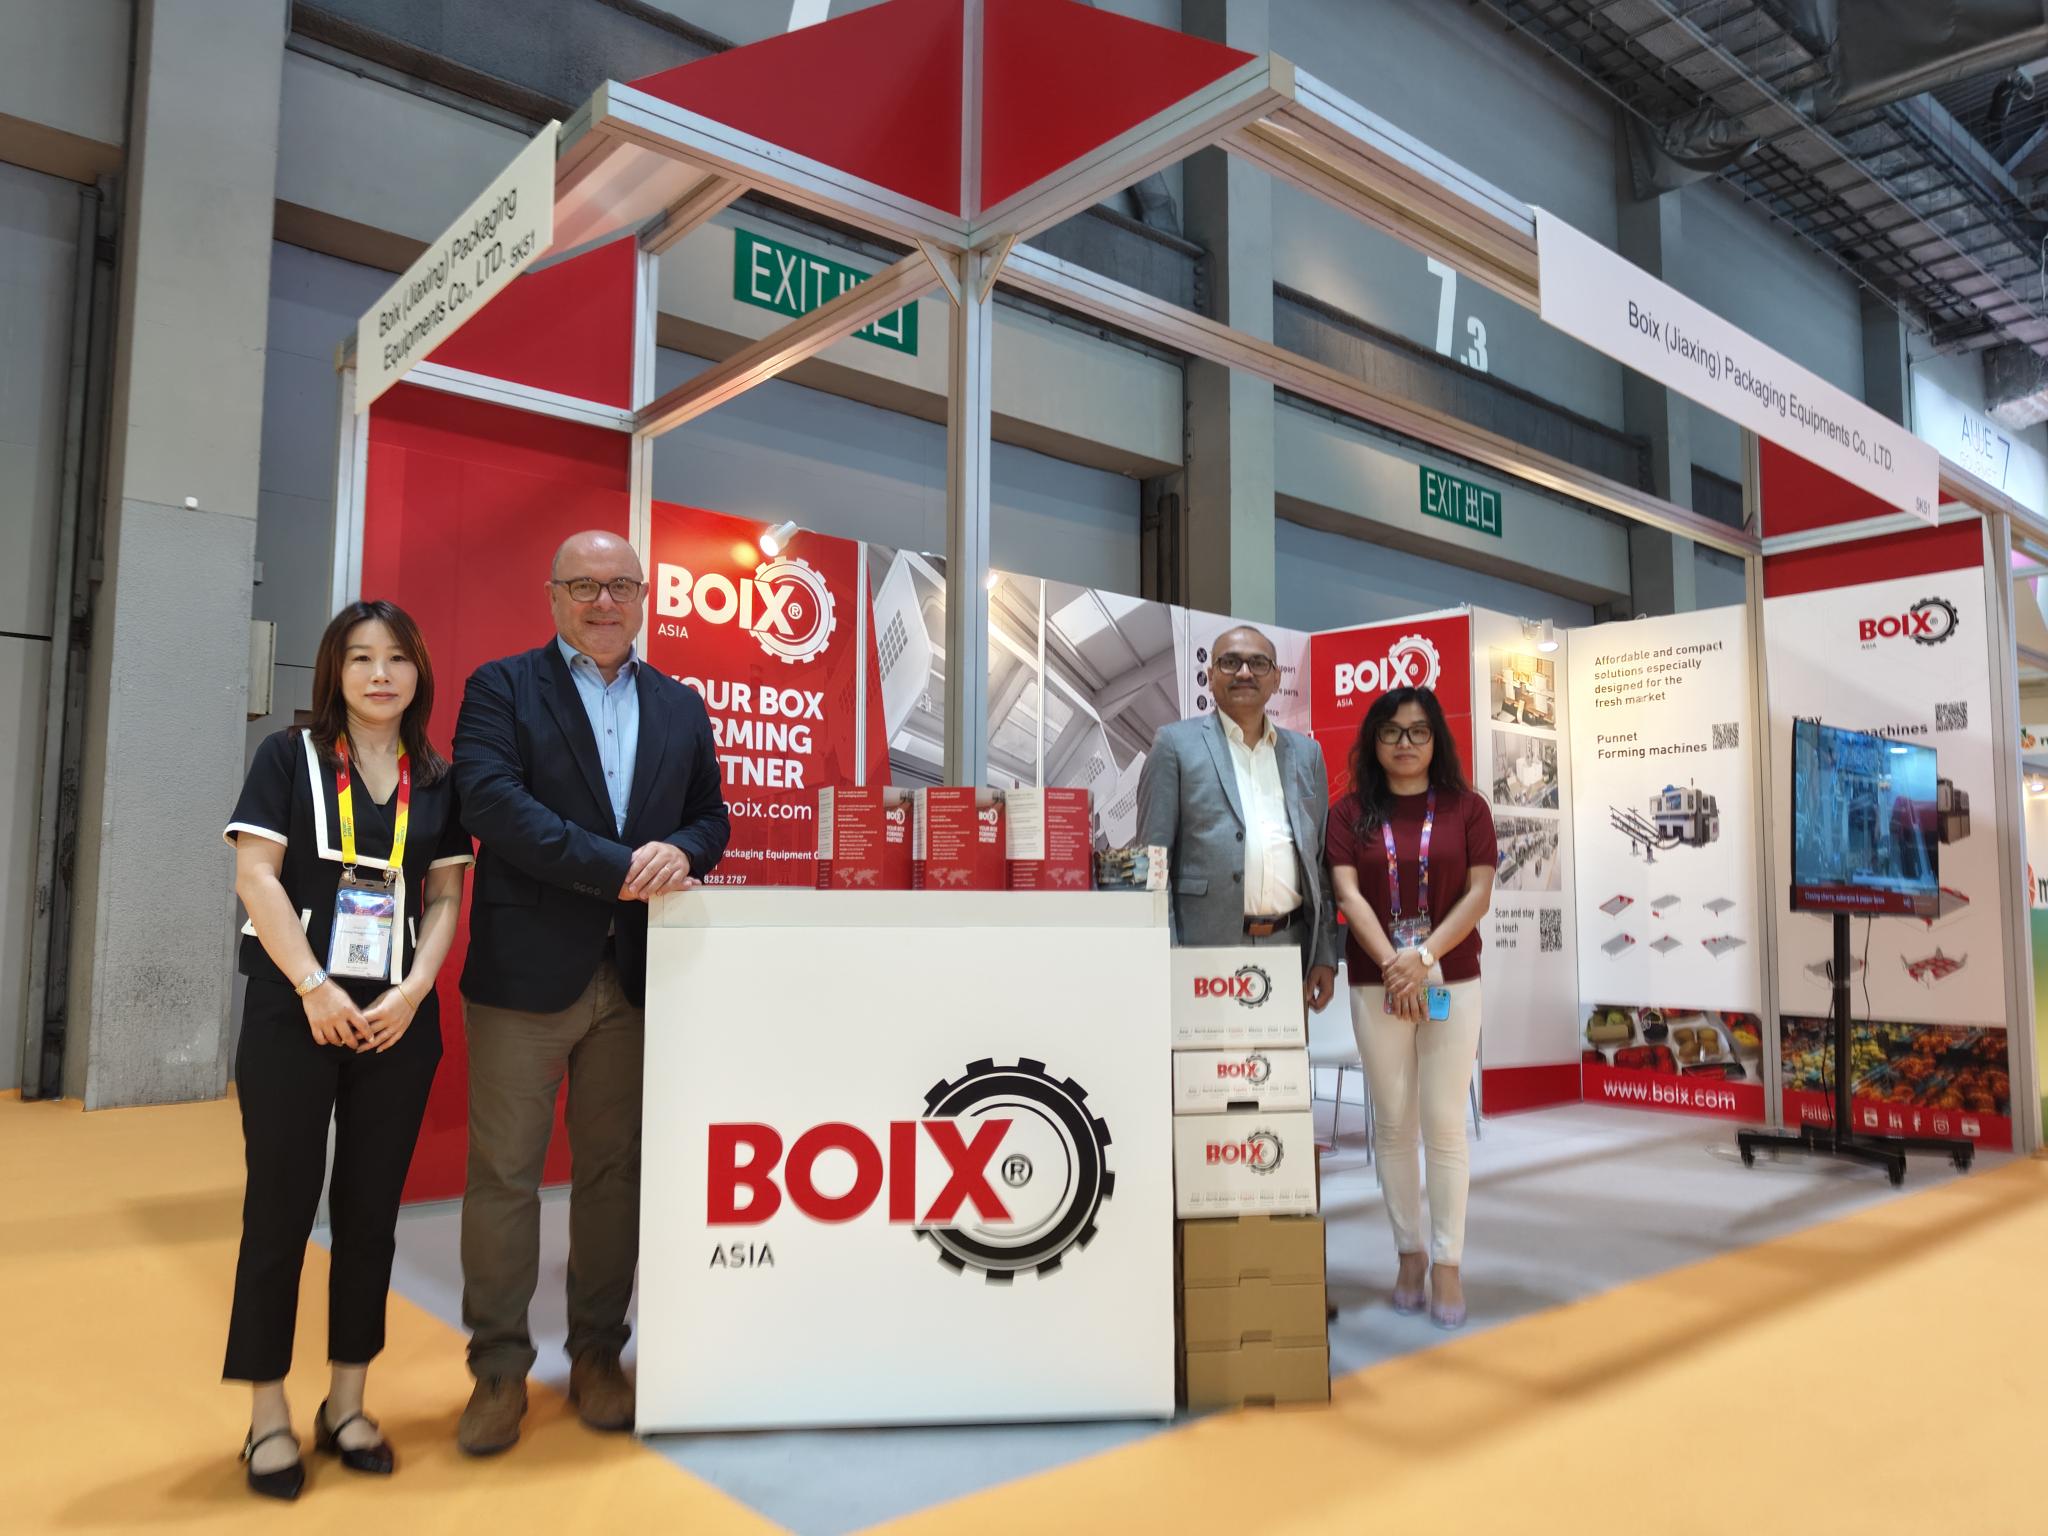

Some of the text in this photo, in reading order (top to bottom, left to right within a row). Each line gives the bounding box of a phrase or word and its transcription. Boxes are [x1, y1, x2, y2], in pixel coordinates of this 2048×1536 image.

[379, 188, 517, 338] Boix (Jiaxing) Packaging
[752, 240, 830, 312] EXIT
[384, 301, 445, 370] Equipments
[477, 242, 506, 287] LTD.
[1629, 300, 1894, 473] Boix (Jiaxing) Packaging Equipments Co., LTD.
[1427, 471, 1496, 532] EXIT 出口
[657, 562, 795, 635] BOIX
[657, 623, 689, 639] ASIA
[1859, 610, 1932, 641] BOIX
[1594, 640, 1723, 666] Affordable and compact
[1335, 653, 1414, 696] BOIX
[1594, 658, 1702, 680] solutions especially
[1594, 675, 1683, 694] designed for the
[671, 675, 825, 720] OUR BOX
[1337, 697, 1353, 708] ASIA
[1595, 691, 1666, 707] fresh market
[709, 716, 812, 755] RMING
[1597, 732, 1638, 744] Punnet
[1856, 723, 1928, 738] machines
[1598, 743, 1708, 759] Forming machines
[716, 755, 805, 789] TNER
[723, 798, 812, 820] oix.com
[723, 848, 763, 860] ackaging
[766, 849, 812, 861] Equipment
[703, 875, 747, 885] 8282 2787
[1495, 908, 1534, 920] Scan and stay
[1502, 922, 1518, 933] touch
[1496, 939, 1517, 948] with us
[1194, 976, 1253, 998] BOIX
[1217, 1063, 1258, 1079] BOIX
[1604, 1079, 1736, 1110] www.boix.com
[1206, 1140, 1264, 1166] BOIX
[706, 1119, 1014, 1227] BOIX
[709, 1241, 775, 1269] ASIA
